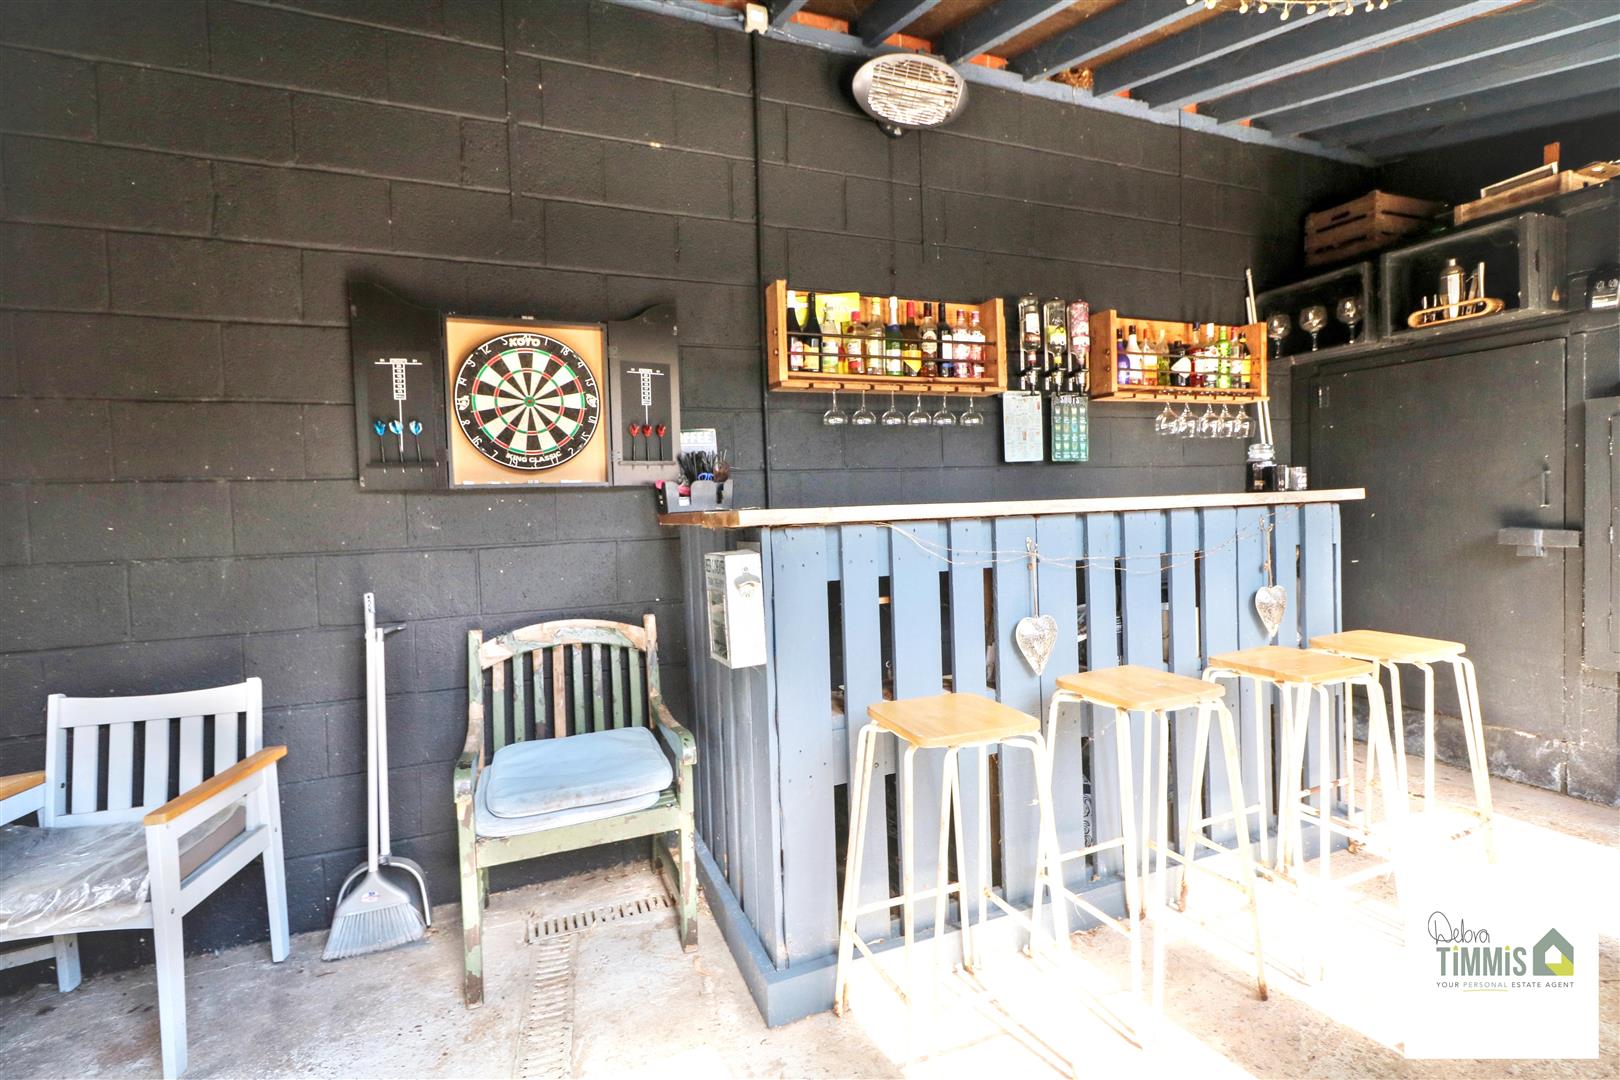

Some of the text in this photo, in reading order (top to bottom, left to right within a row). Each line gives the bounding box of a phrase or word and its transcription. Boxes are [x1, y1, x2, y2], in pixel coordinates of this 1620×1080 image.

[508, 337, 541, 347] KOTO
[479, 345, 492, 356] 12
[560, 346, 570, 356] 18
[1060, 395, 1080, 404] STS
[472, 435, 483, 447] 16
[506, 452, 562, 463] KING CLASSIC
